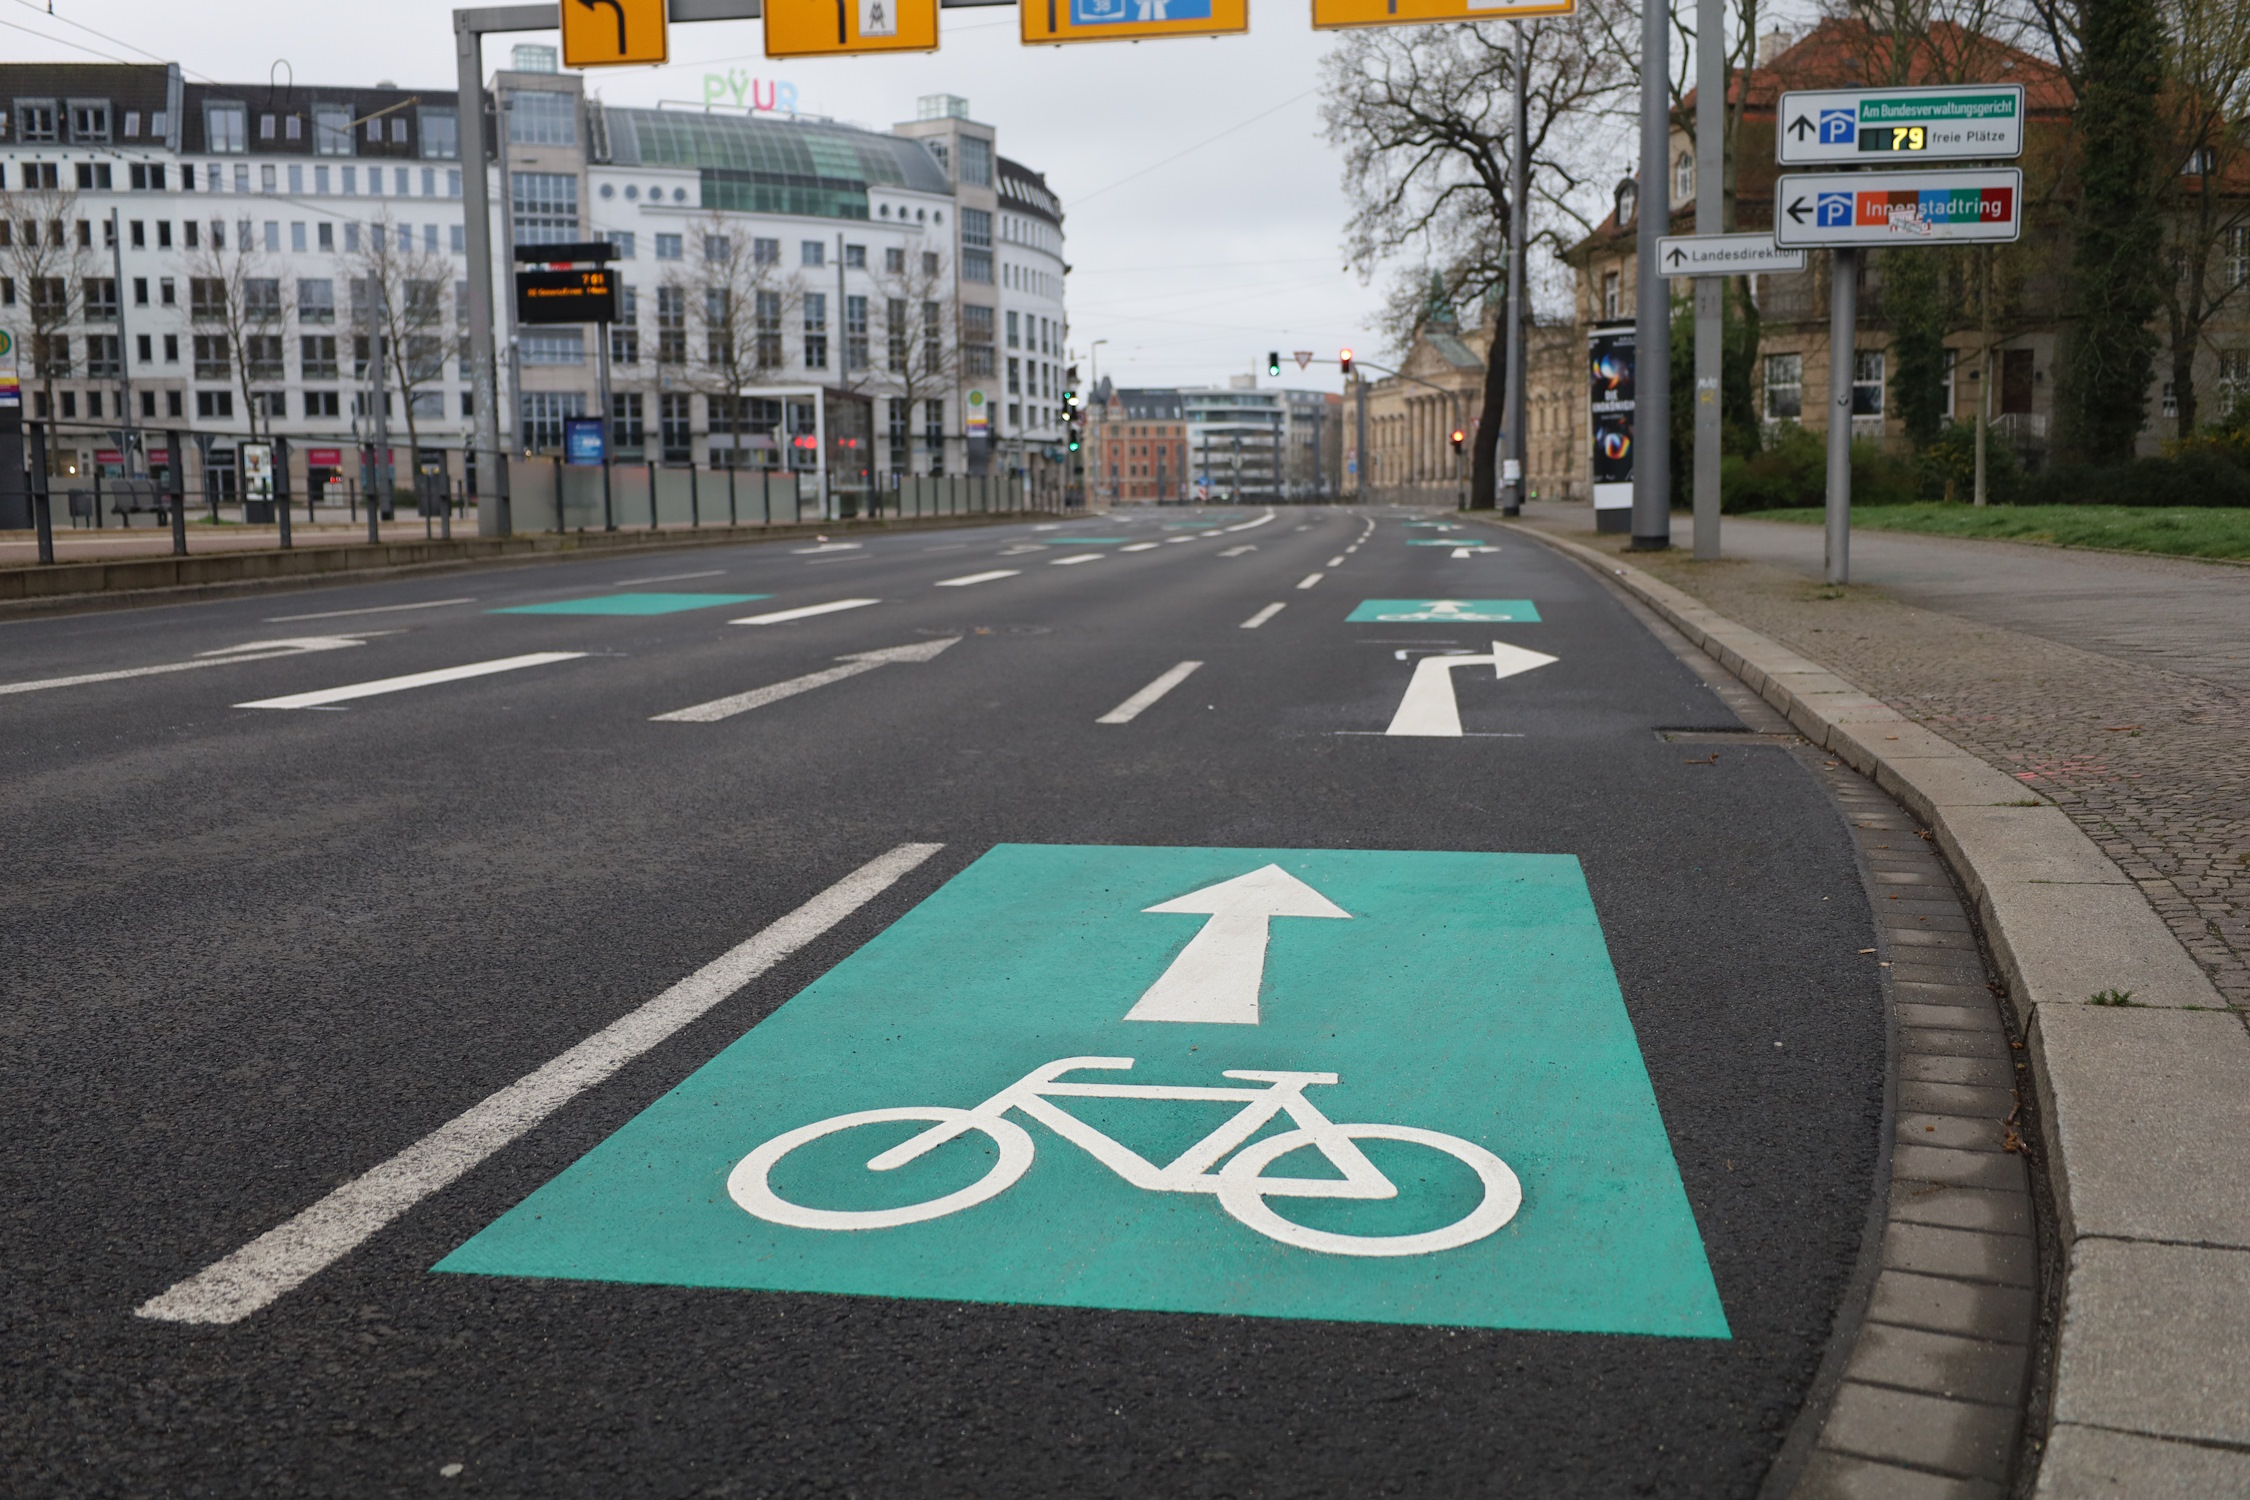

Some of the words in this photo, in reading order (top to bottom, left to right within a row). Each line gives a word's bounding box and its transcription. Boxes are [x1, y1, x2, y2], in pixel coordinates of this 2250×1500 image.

[703, 67, 799, 115] PŸUR
[1862, 104, 1880, 118] Am
[1881, 99, 2013, 118] Bundesverwaltungsgericht
[1891, 127, 1925, 151] 79
[1932, 131, 1961, 143] freie
[1966, 130, 2005, 143] Plätze
[1865, 197, 2002, 218] Innenstadtring
